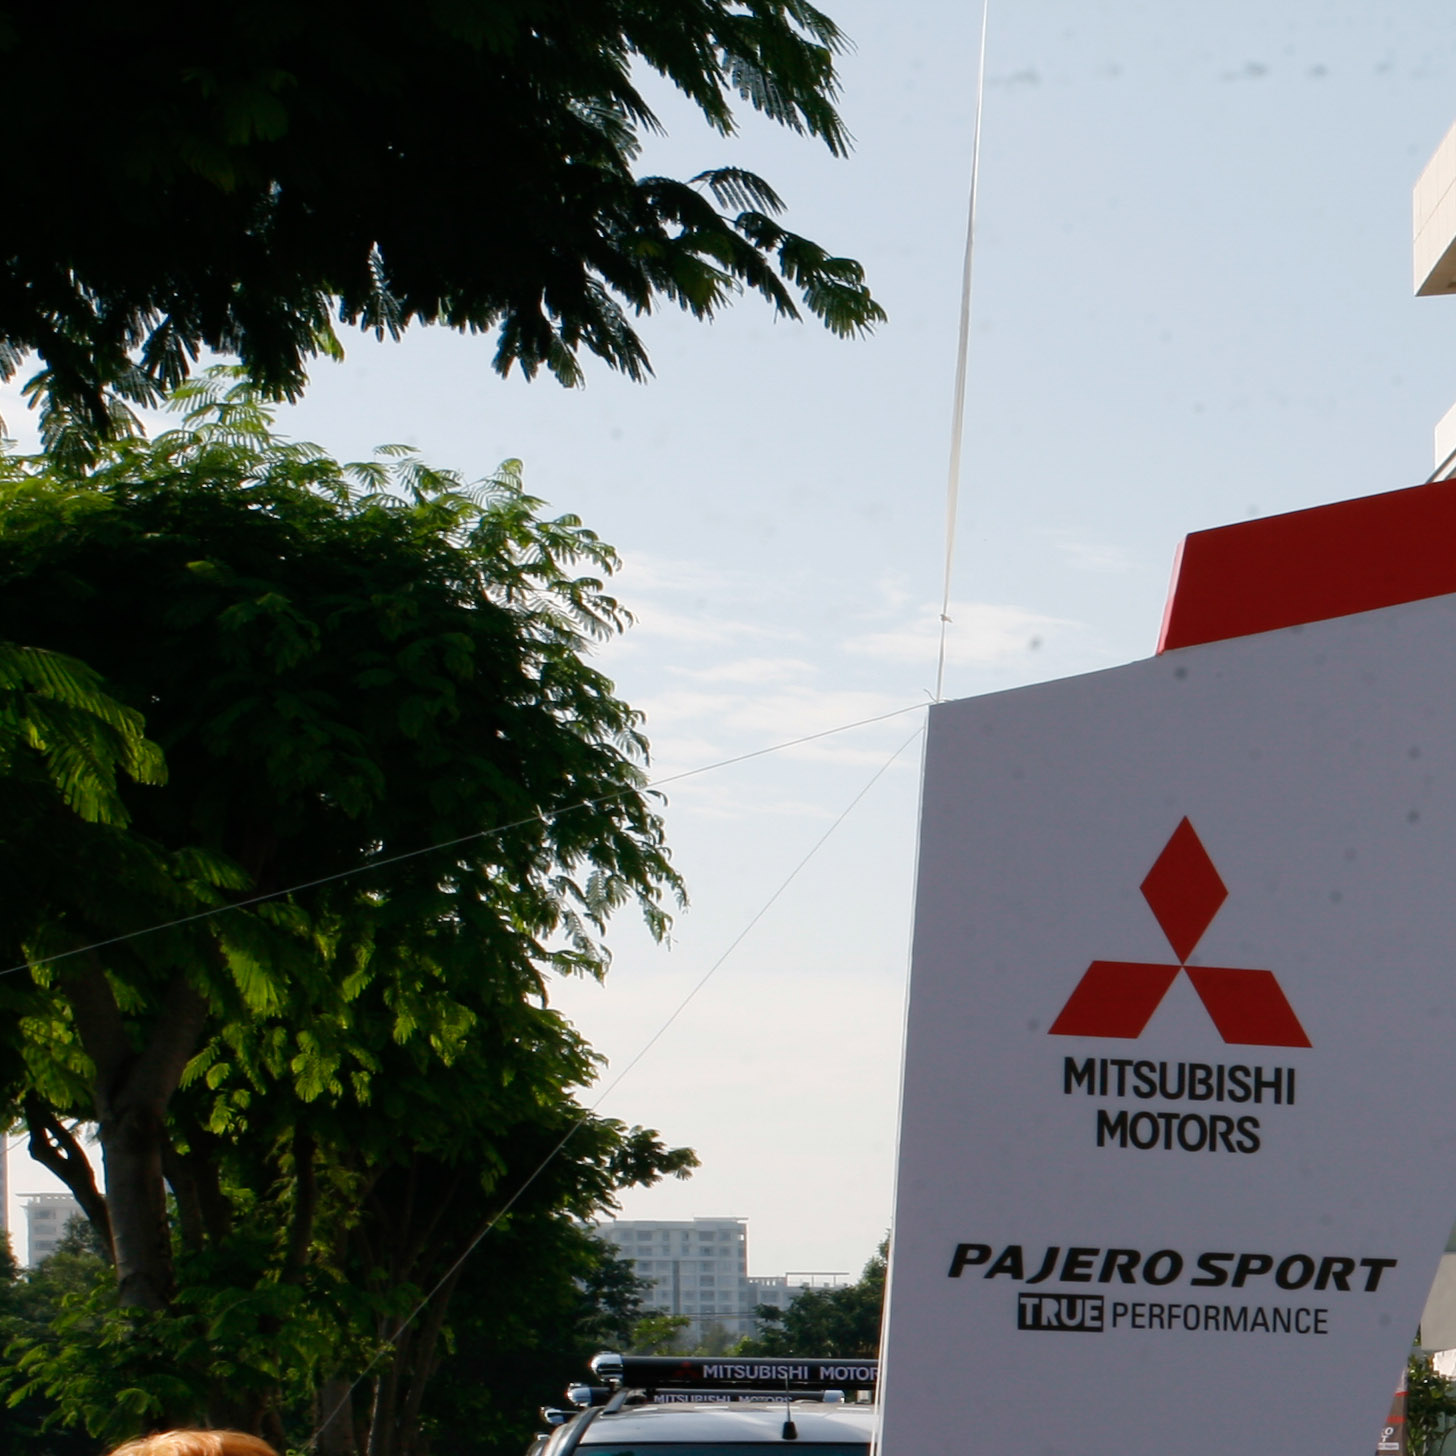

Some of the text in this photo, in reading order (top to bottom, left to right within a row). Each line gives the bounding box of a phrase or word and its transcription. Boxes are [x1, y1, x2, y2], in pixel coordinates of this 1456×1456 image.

[1062, 1056, 1296, 1105] MITSUBISHI
[1096, 1109, 1261, 1154] MOTORS
[948, 1243, 1398, 1292] PAJERO SPORT
[1018, 1294, 1329, 1335] TRUE PERFORMANCE
[703, 1365, 878, 1381] MITSUBISHI MOTOR
